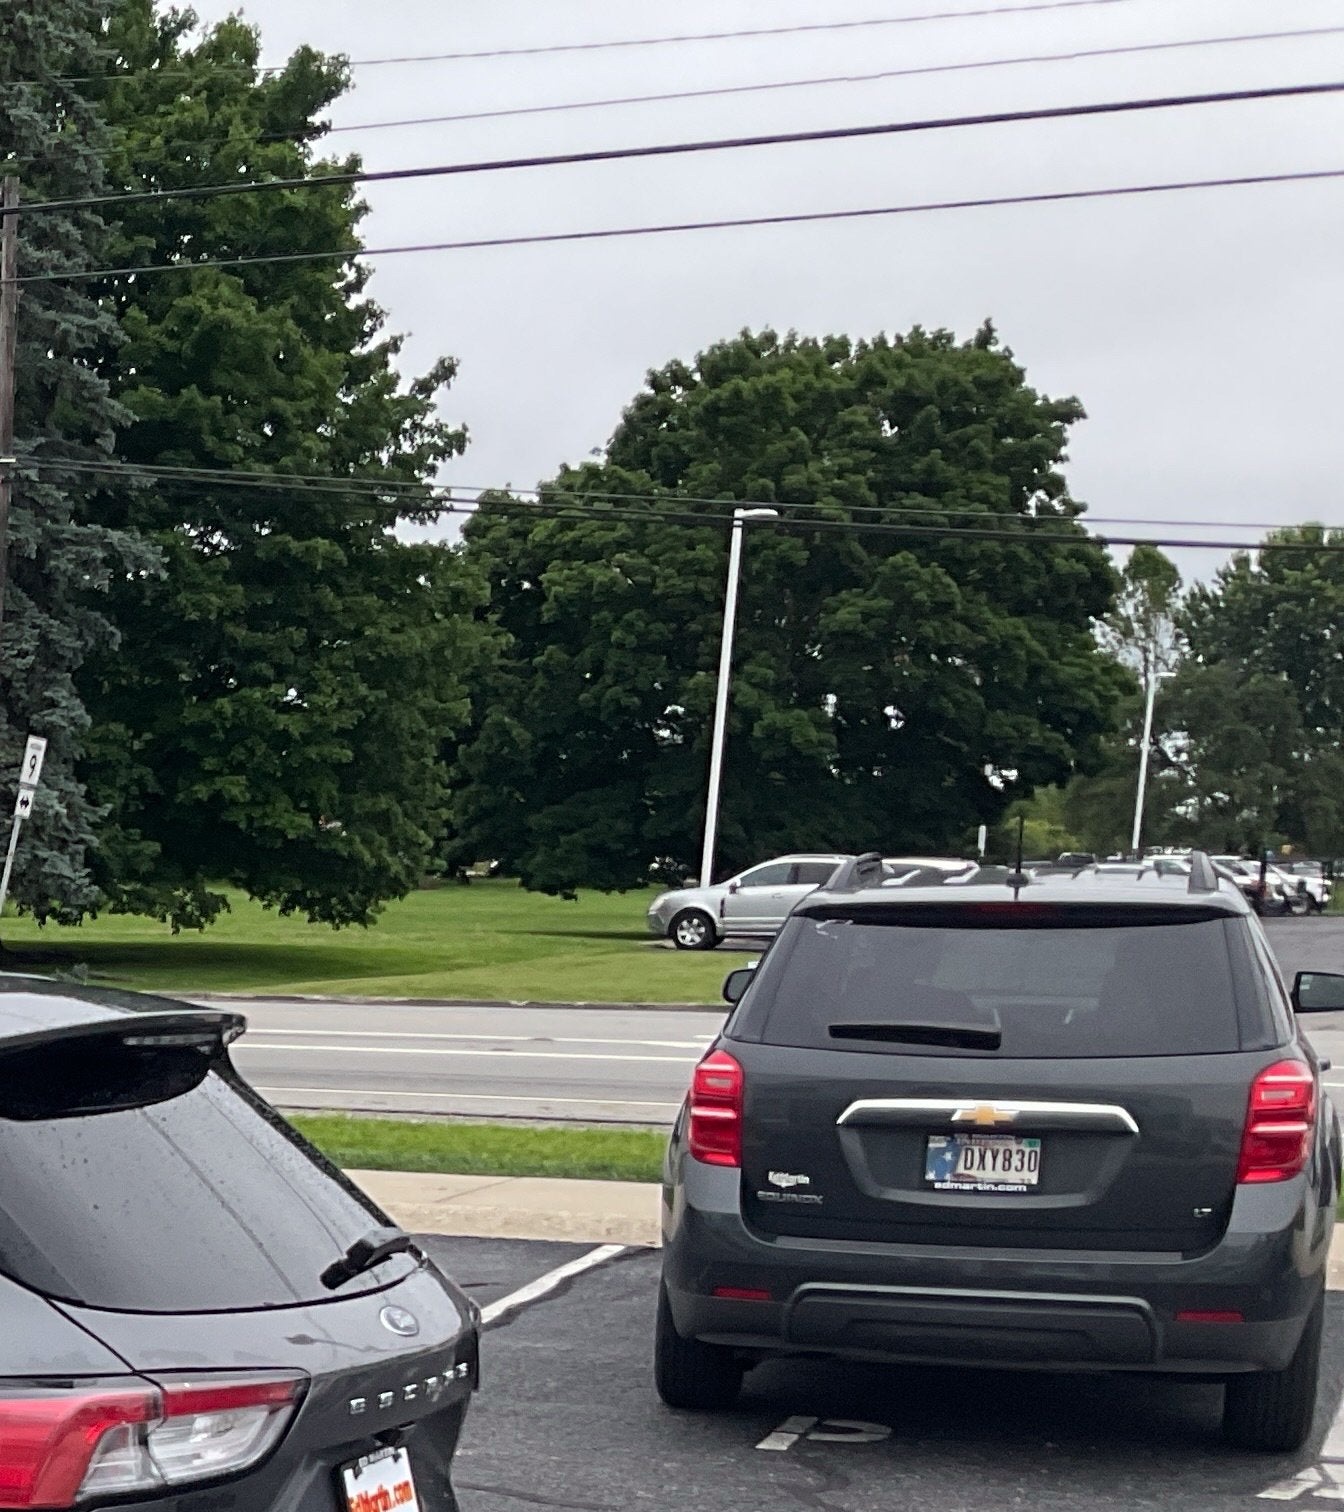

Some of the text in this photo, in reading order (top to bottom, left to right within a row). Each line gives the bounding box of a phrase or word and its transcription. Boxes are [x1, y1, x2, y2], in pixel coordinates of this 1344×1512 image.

[28, 754, 37, 779] 9
[963, 1147, 1038, 1173] DXY830
[934, 1181, 1028, 1192] edmartin.com
[350, 1362, 468, 1415] ESCAPE
